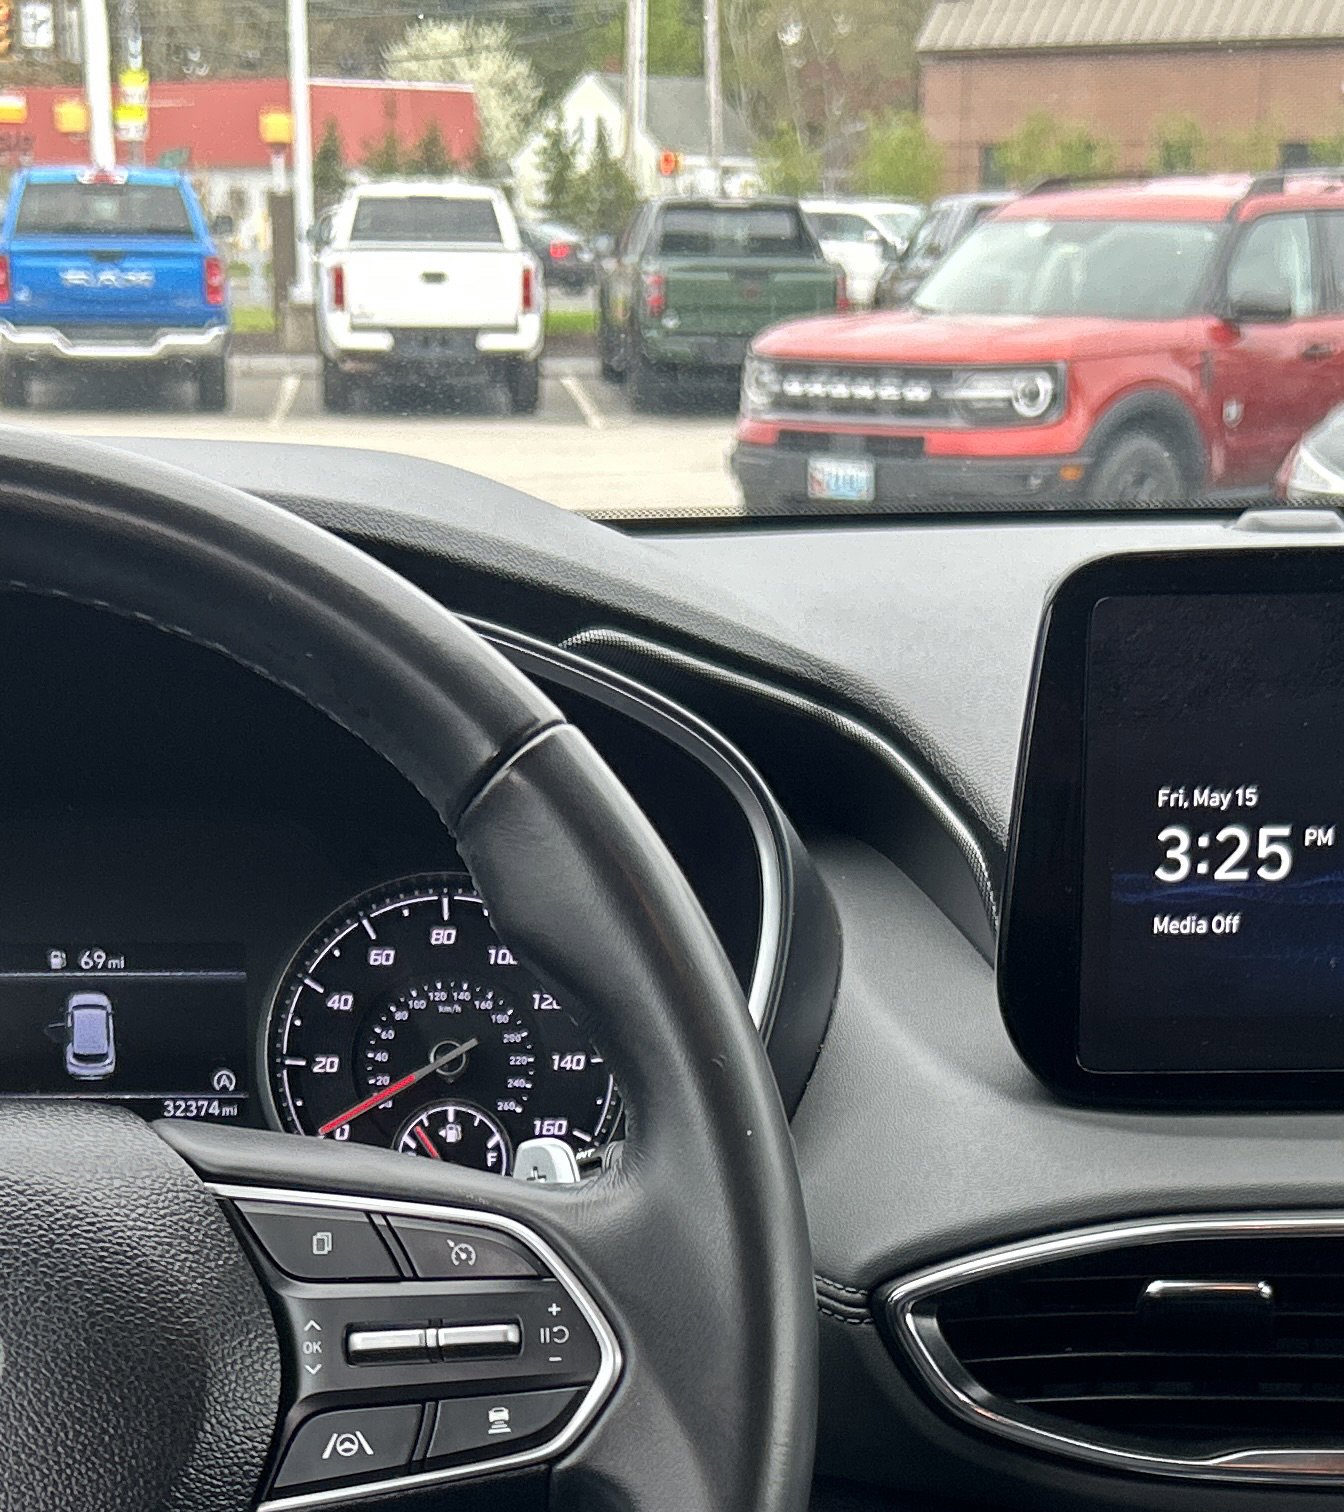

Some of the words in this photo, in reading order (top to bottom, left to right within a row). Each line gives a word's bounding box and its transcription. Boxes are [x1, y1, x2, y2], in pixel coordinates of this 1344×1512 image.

[1158, 788, 1189, 808] Fri,
[1193, 788, 1232, 810] May
[1236, 787, 1258, 806] 15
[1154, 826, 1293, 882] 3:25
[1305, 827, 1335, 846] PM
[1153, 915, 1207, 934] Media
[1211, 914, 1241, 934] Off
[431, 929, 456, 945] 80
[369, 950, 395, 965] 60
[327, 994, 354, 1010] 40
[429, 992, 447, 1001] 120
[453, 992, 471, 1001] 140
[438, 1004, 462, 1014] km/h
[375, 1052, 388, 1062] 40
[509, 1056, 528, 1065] 220
[552, 1055, 586, 1071] 140
[312, 1057, 339, 1073] 20
[376, 1076, 390, 1085] 20
[507, 1079, 526, 1088] 240
[335, 1124, 350, 1141] 0
[533, 1119, 567, 1135] 160
[486, 1152, 498, 1167] F
[303, 1341, 322, 1354] OK
